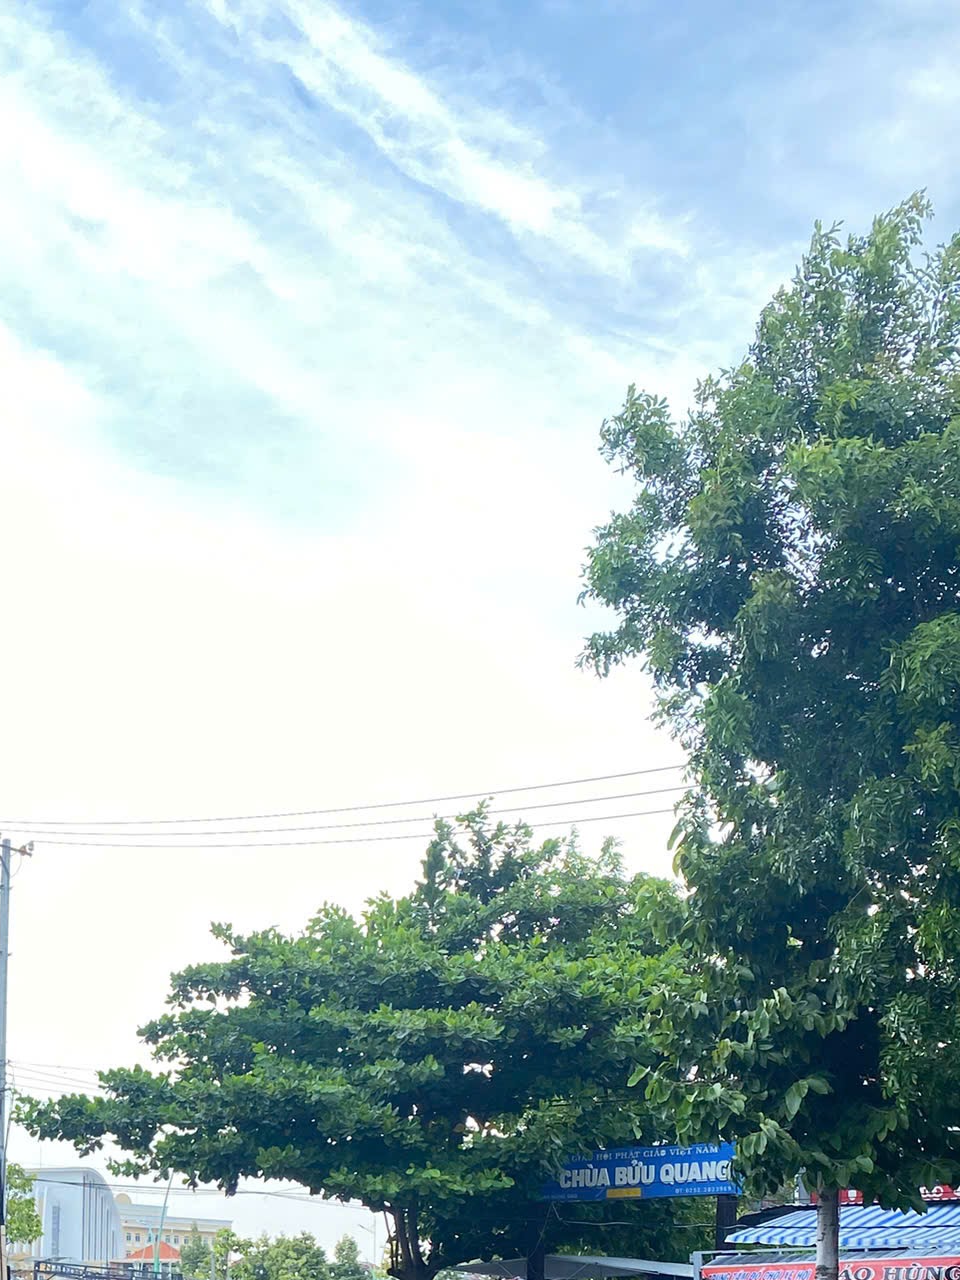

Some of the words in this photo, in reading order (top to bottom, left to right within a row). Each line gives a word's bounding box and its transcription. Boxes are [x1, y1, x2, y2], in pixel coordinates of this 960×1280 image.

[695, 1145, 719, 1154] NAM
[559, 1163, 611, 1188] CHÙA
[615, 1160, 657, 1187] BỬU
[659, 1159, 732, 1186] QUANG
